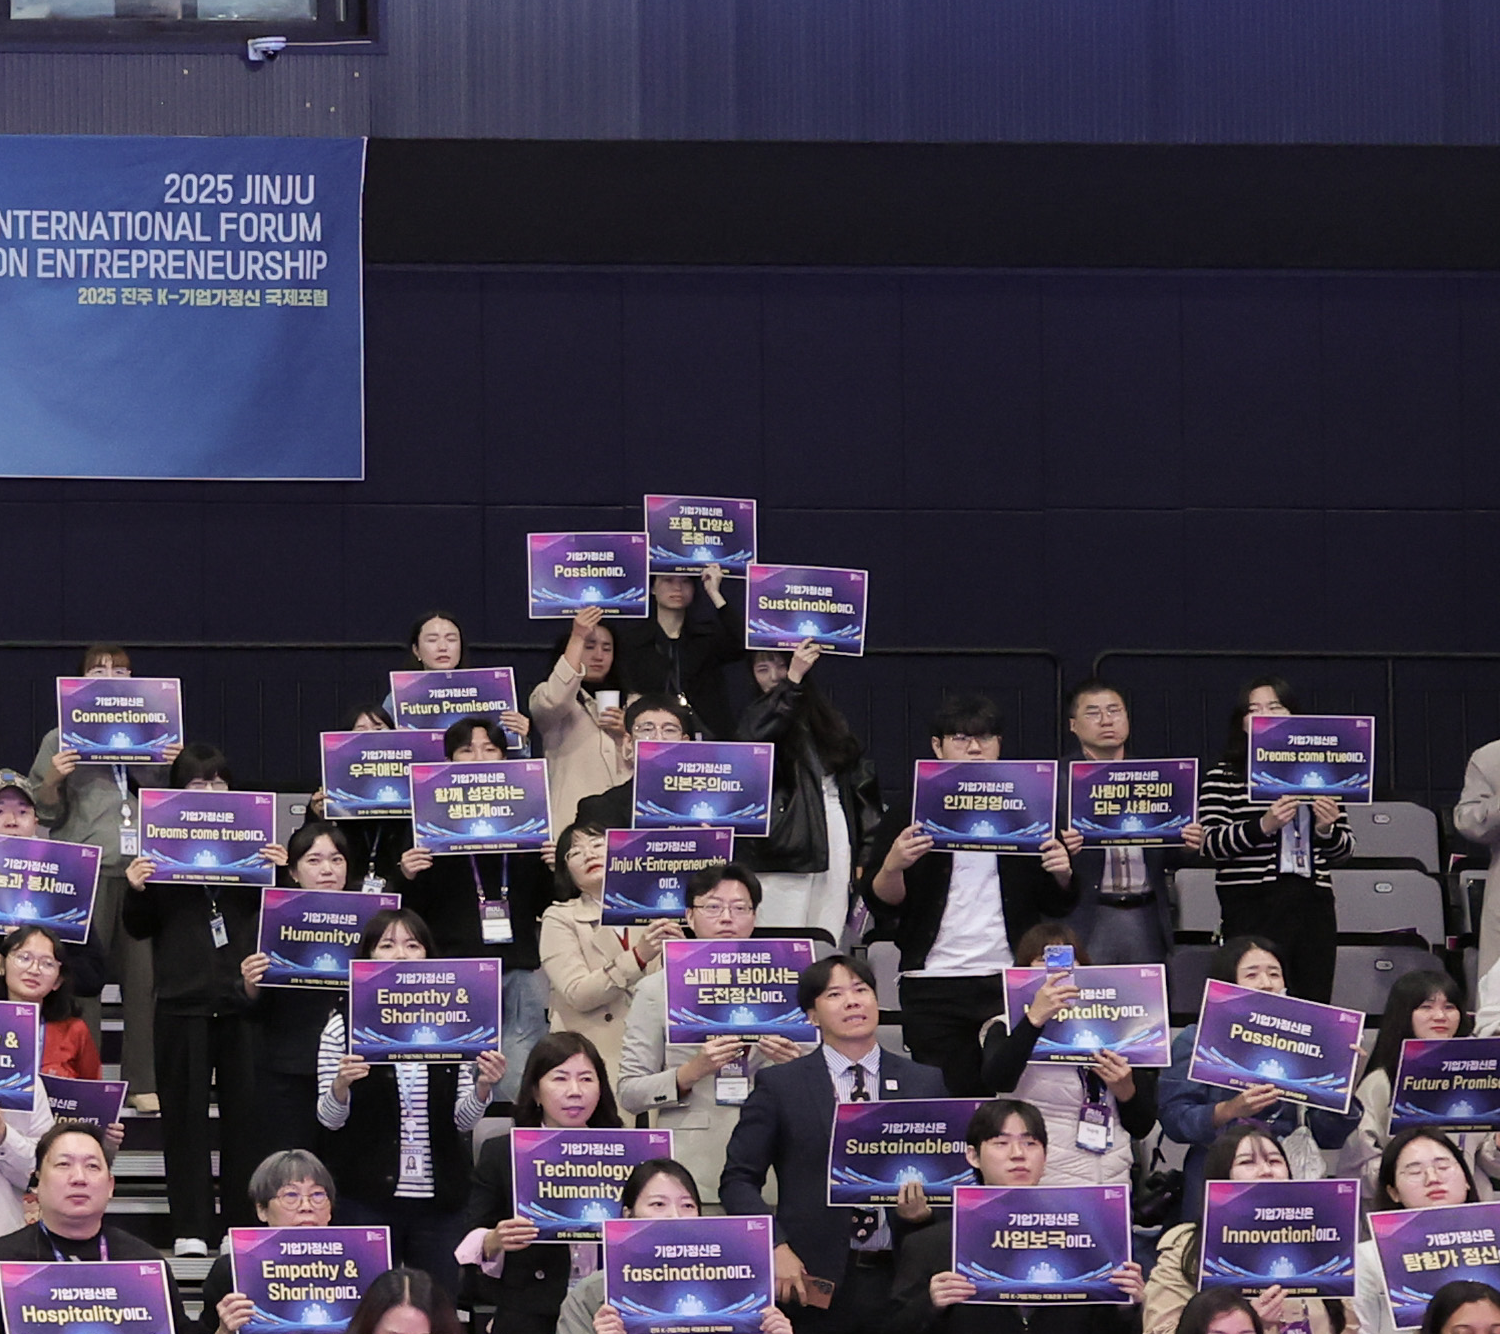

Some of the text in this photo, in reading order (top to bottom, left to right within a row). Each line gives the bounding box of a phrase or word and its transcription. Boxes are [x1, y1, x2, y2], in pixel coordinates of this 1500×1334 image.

[164, 173, 315, 205] 2025 JINJU
[220, 212, 322, 243] FORUM
[37, 248, 328, 281] ENTREPRENEURSHIP
[78, 287, 328, 307] 2025 진주 K-기업가정신 국제포럼
[943, 794, 1027, 811] 인재경영이다.
[146, 823, 267, 842] Dreams come true이다.
[1254, 1207, 1314, 1221] 기업가정신은
[1222, 1224, 1341, 1244] Innovation!이다.
